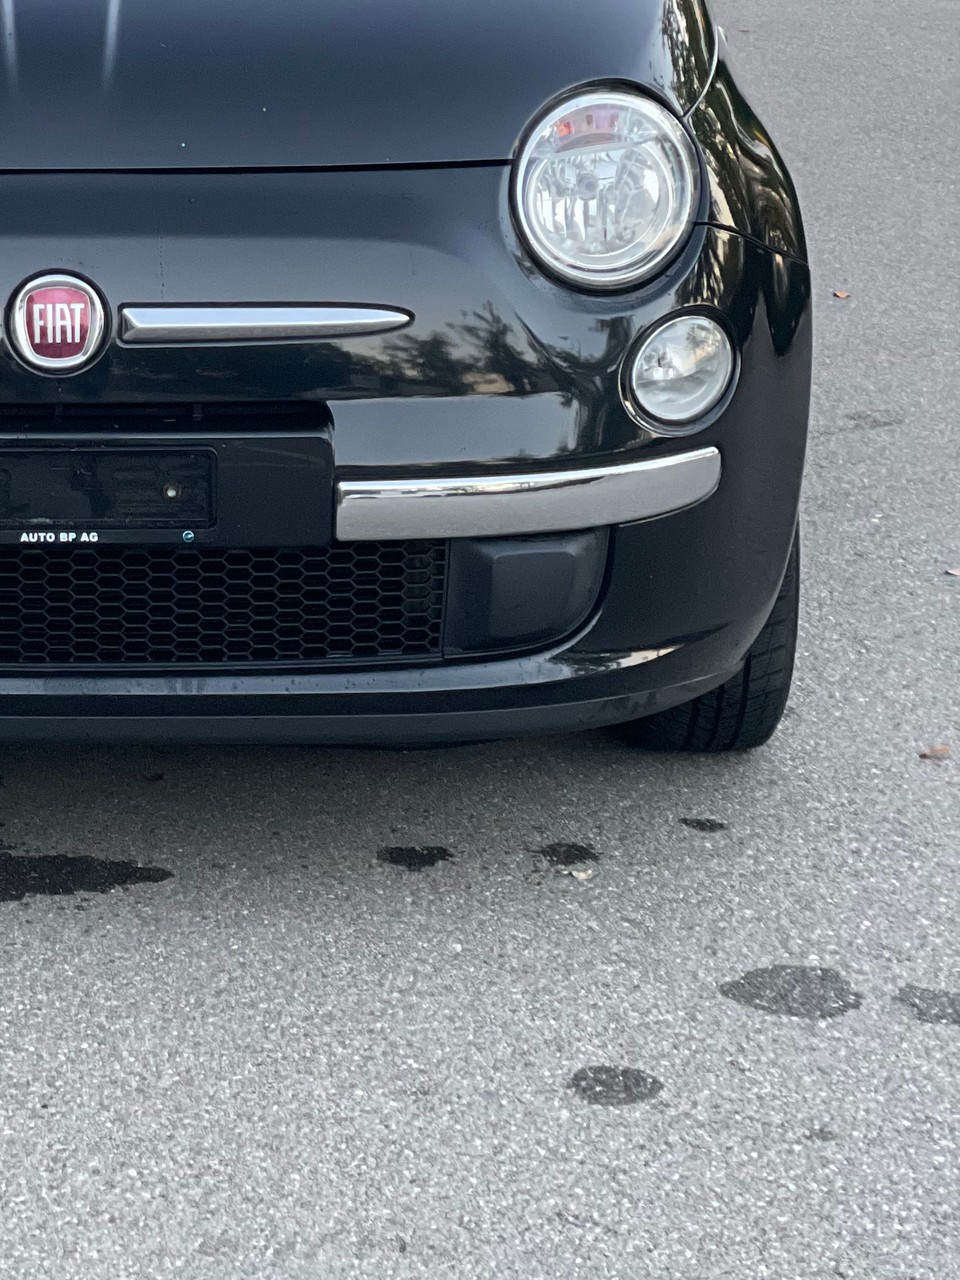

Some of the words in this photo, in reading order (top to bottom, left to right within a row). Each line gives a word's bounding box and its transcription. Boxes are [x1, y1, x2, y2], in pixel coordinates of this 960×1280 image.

[33, 303, 85, 344] FIAT
[20, 532, 56, 543] AUTO
[59, 532, 77, 543] BP
[80, 532, 99, 543] AG
